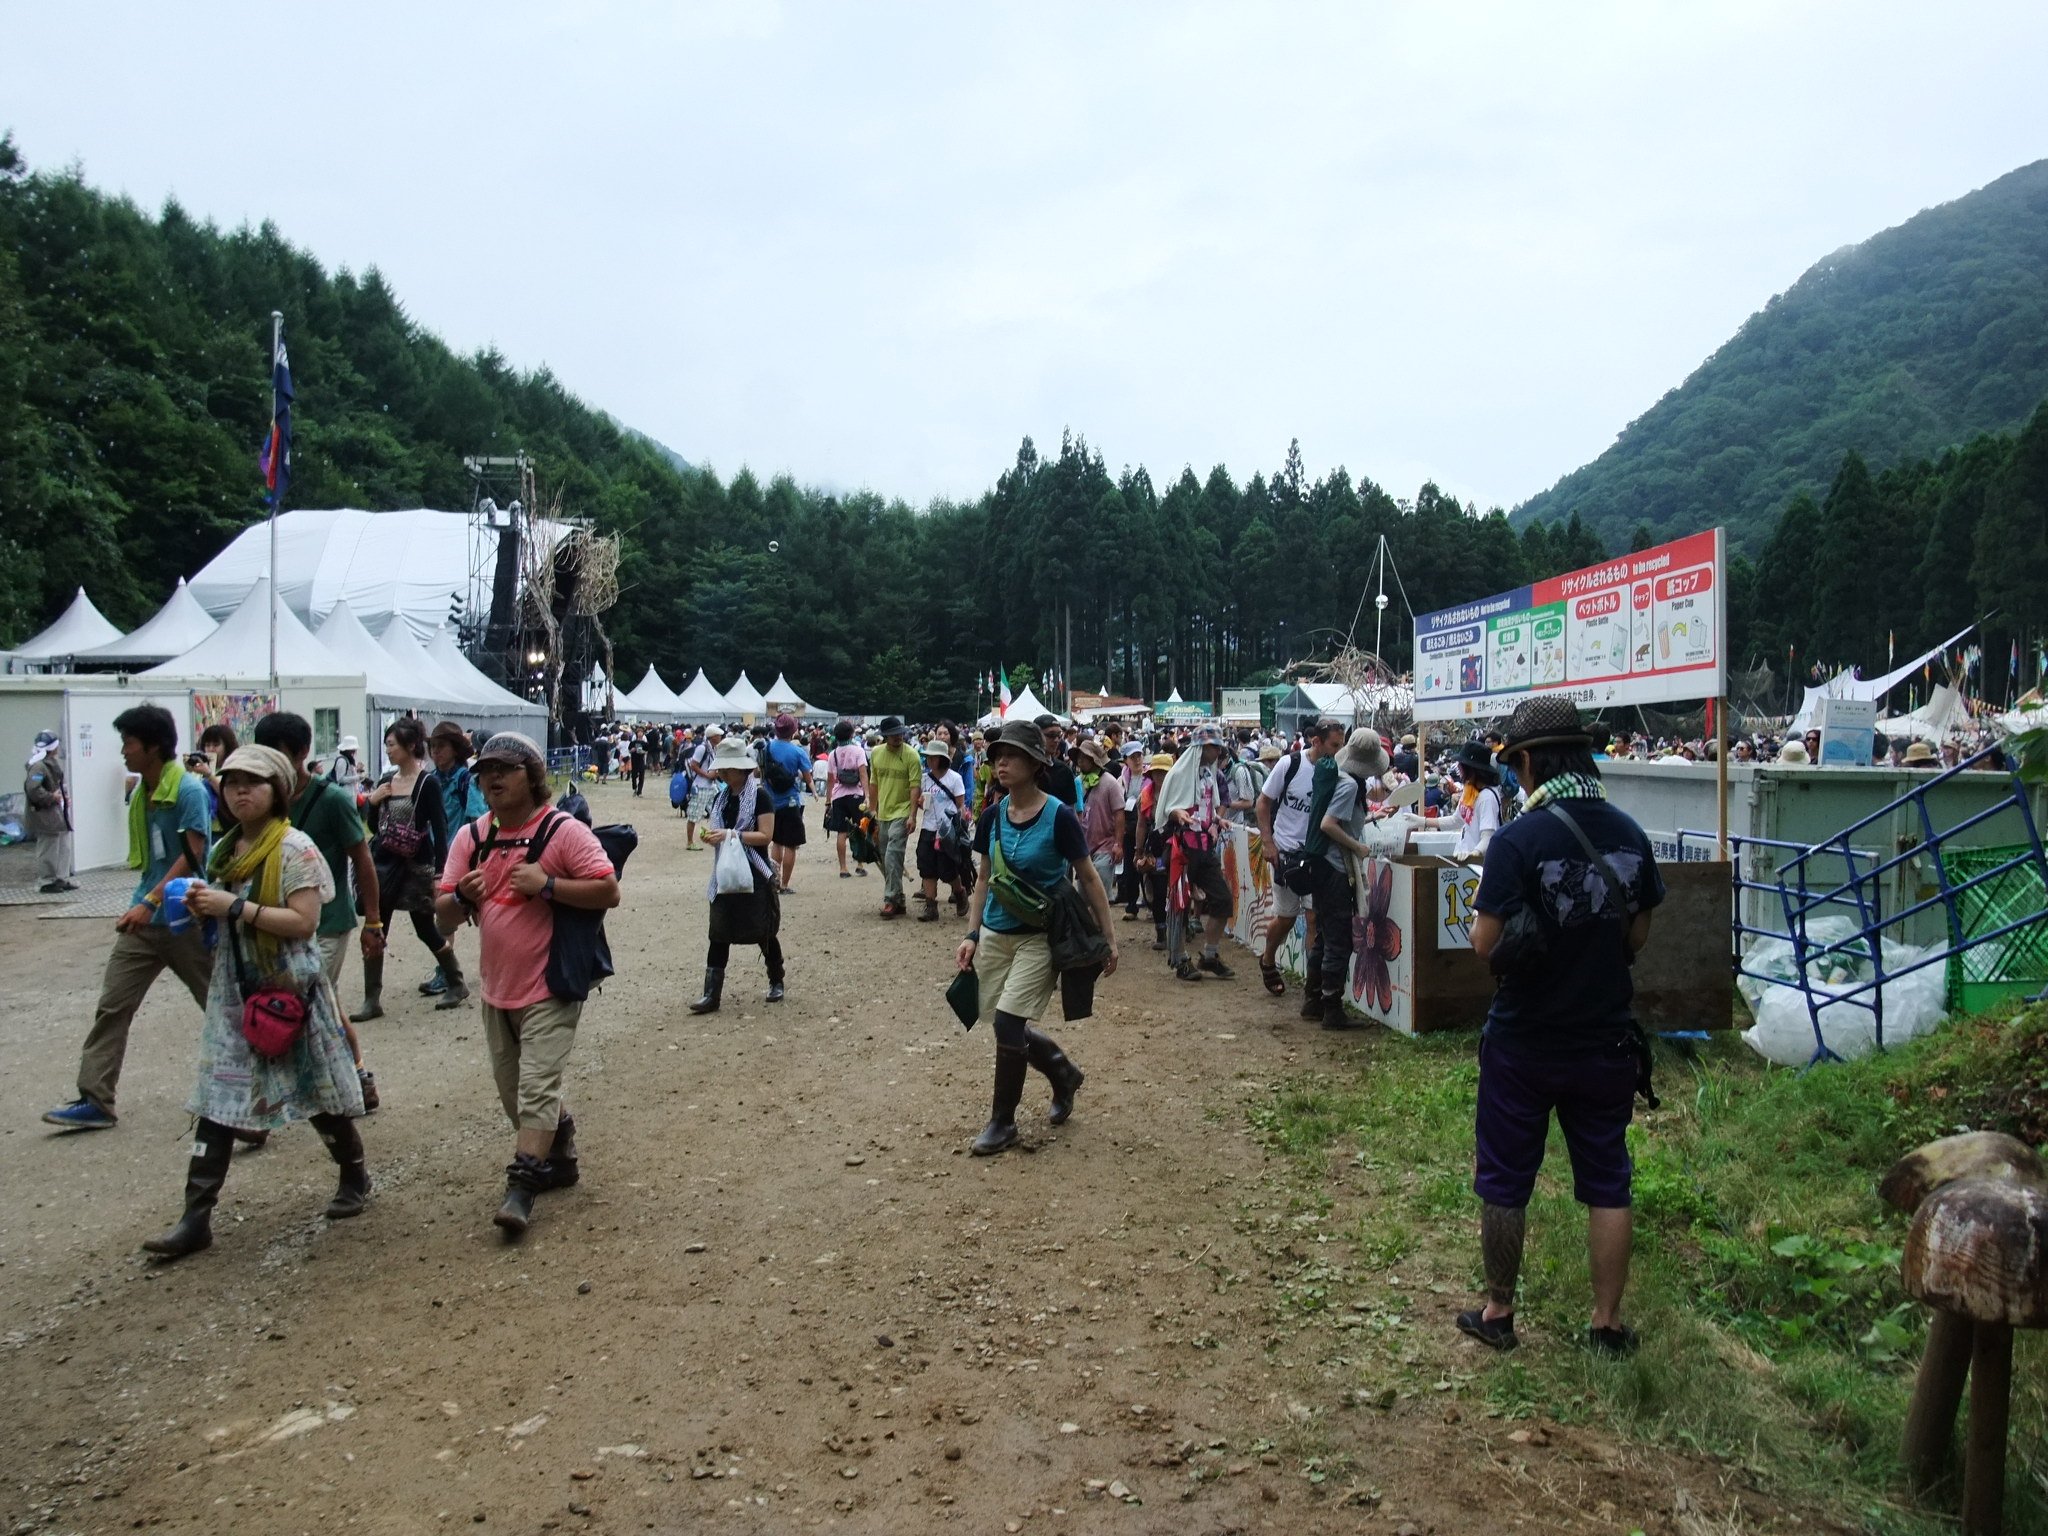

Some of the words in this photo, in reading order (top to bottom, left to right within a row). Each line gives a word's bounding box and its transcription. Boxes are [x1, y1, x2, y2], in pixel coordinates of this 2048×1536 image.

[1646, 552, 1670, 572] recycled
[1561, 563, 1628, 596] リサイクルされるもの
[1667, 572, 1699, 597] 紙コップ
[1578, 594, 1617, 616] ペットボトル
[1634, 592, 1650, 603] キャップ
[1671, 600, 1684, 611] Paper
[1685, 598, 1694, 609] Cup
[1431, 605, 1480, 629] リサイクルされないもの
